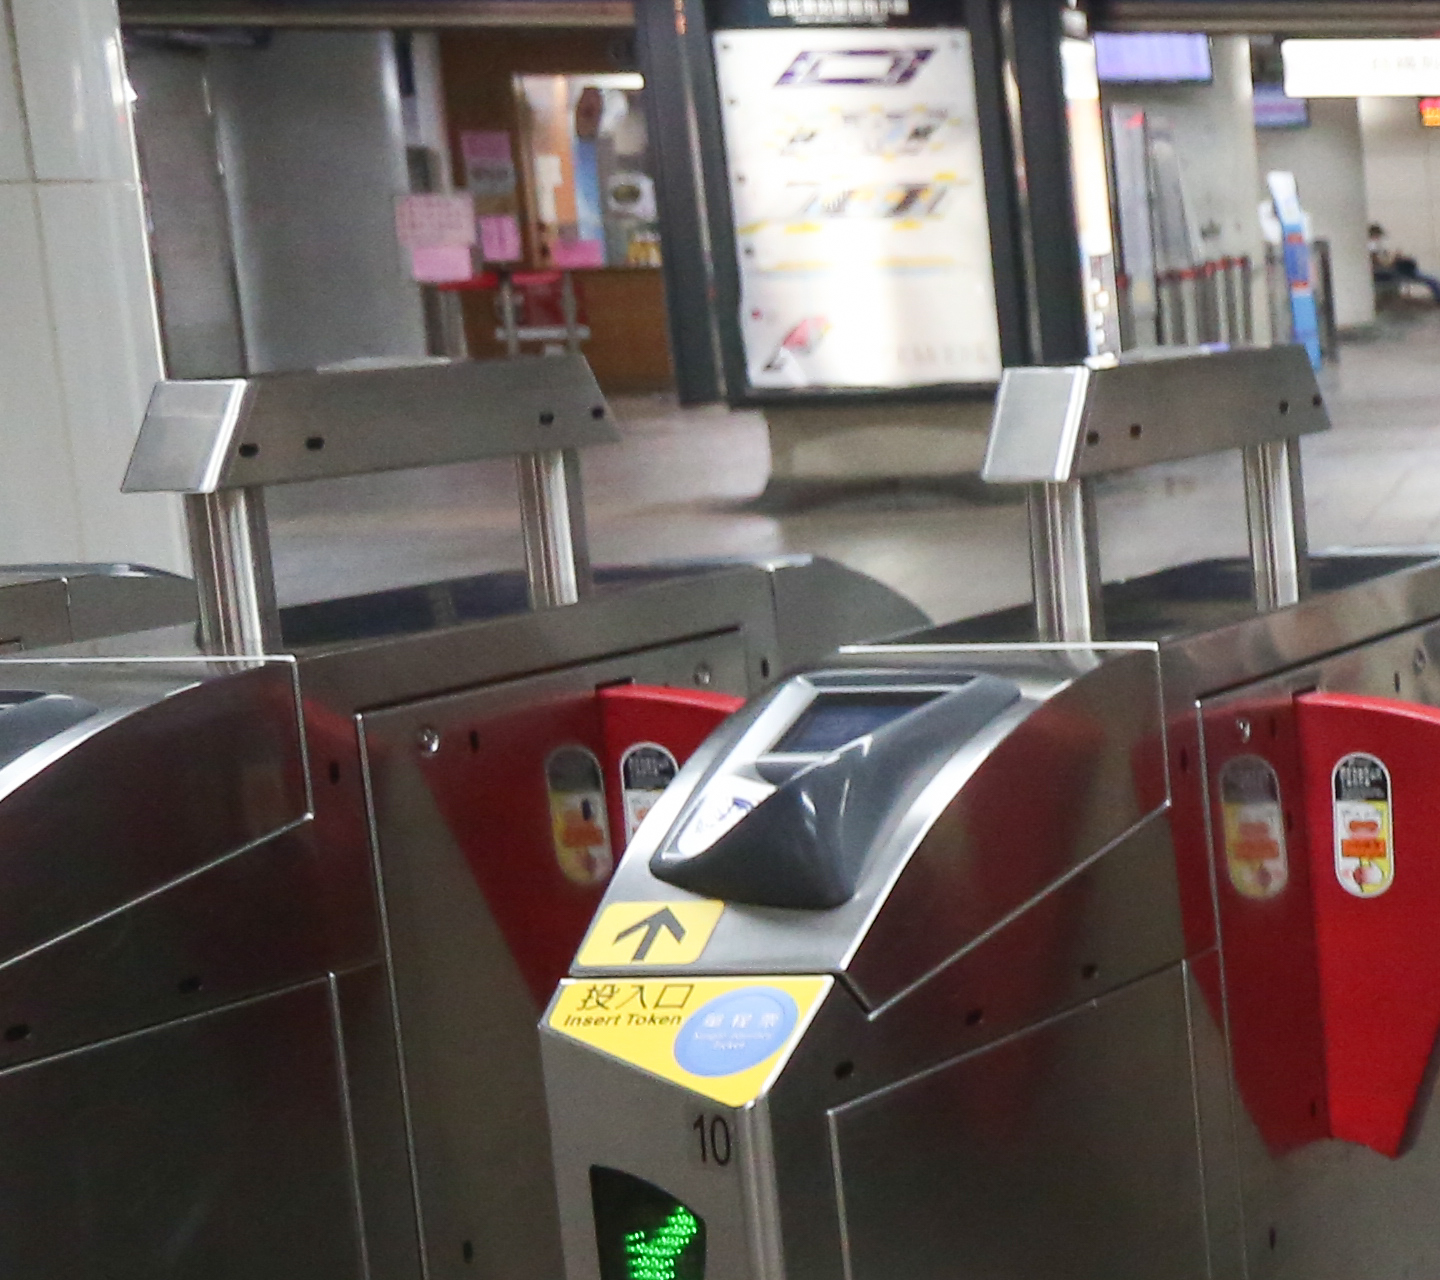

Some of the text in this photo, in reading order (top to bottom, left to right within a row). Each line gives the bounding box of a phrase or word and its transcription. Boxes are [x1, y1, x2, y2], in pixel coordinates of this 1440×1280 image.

[577, 984, 694, 1010] 投入口
[563, 1013, 681, 1027] Insert Token
[693, 1114, 731, 1167] 10
